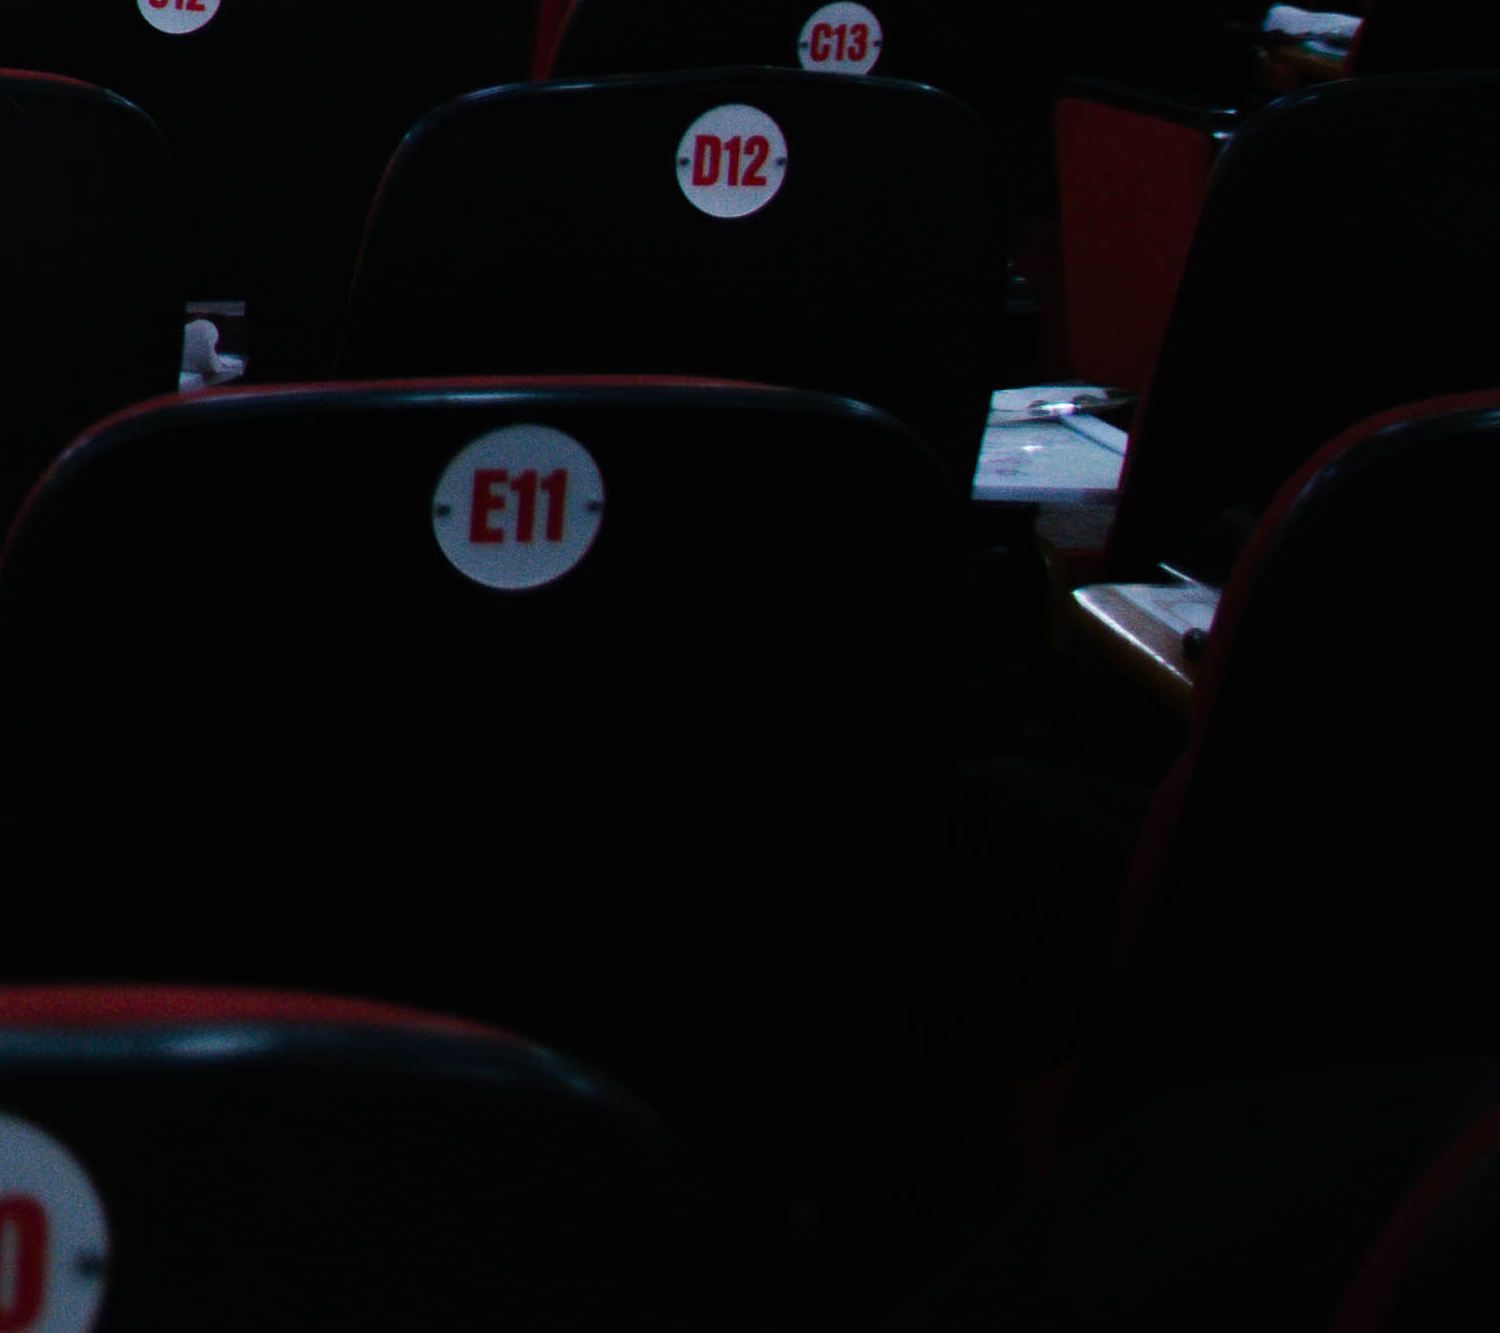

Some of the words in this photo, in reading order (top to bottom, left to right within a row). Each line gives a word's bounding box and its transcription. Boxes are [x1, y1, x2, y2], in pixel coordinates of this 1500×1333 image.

[810, 23, 868, 61] C13
[692, 134, 769, 187] D12
[469, 469, 566, 544] E11
